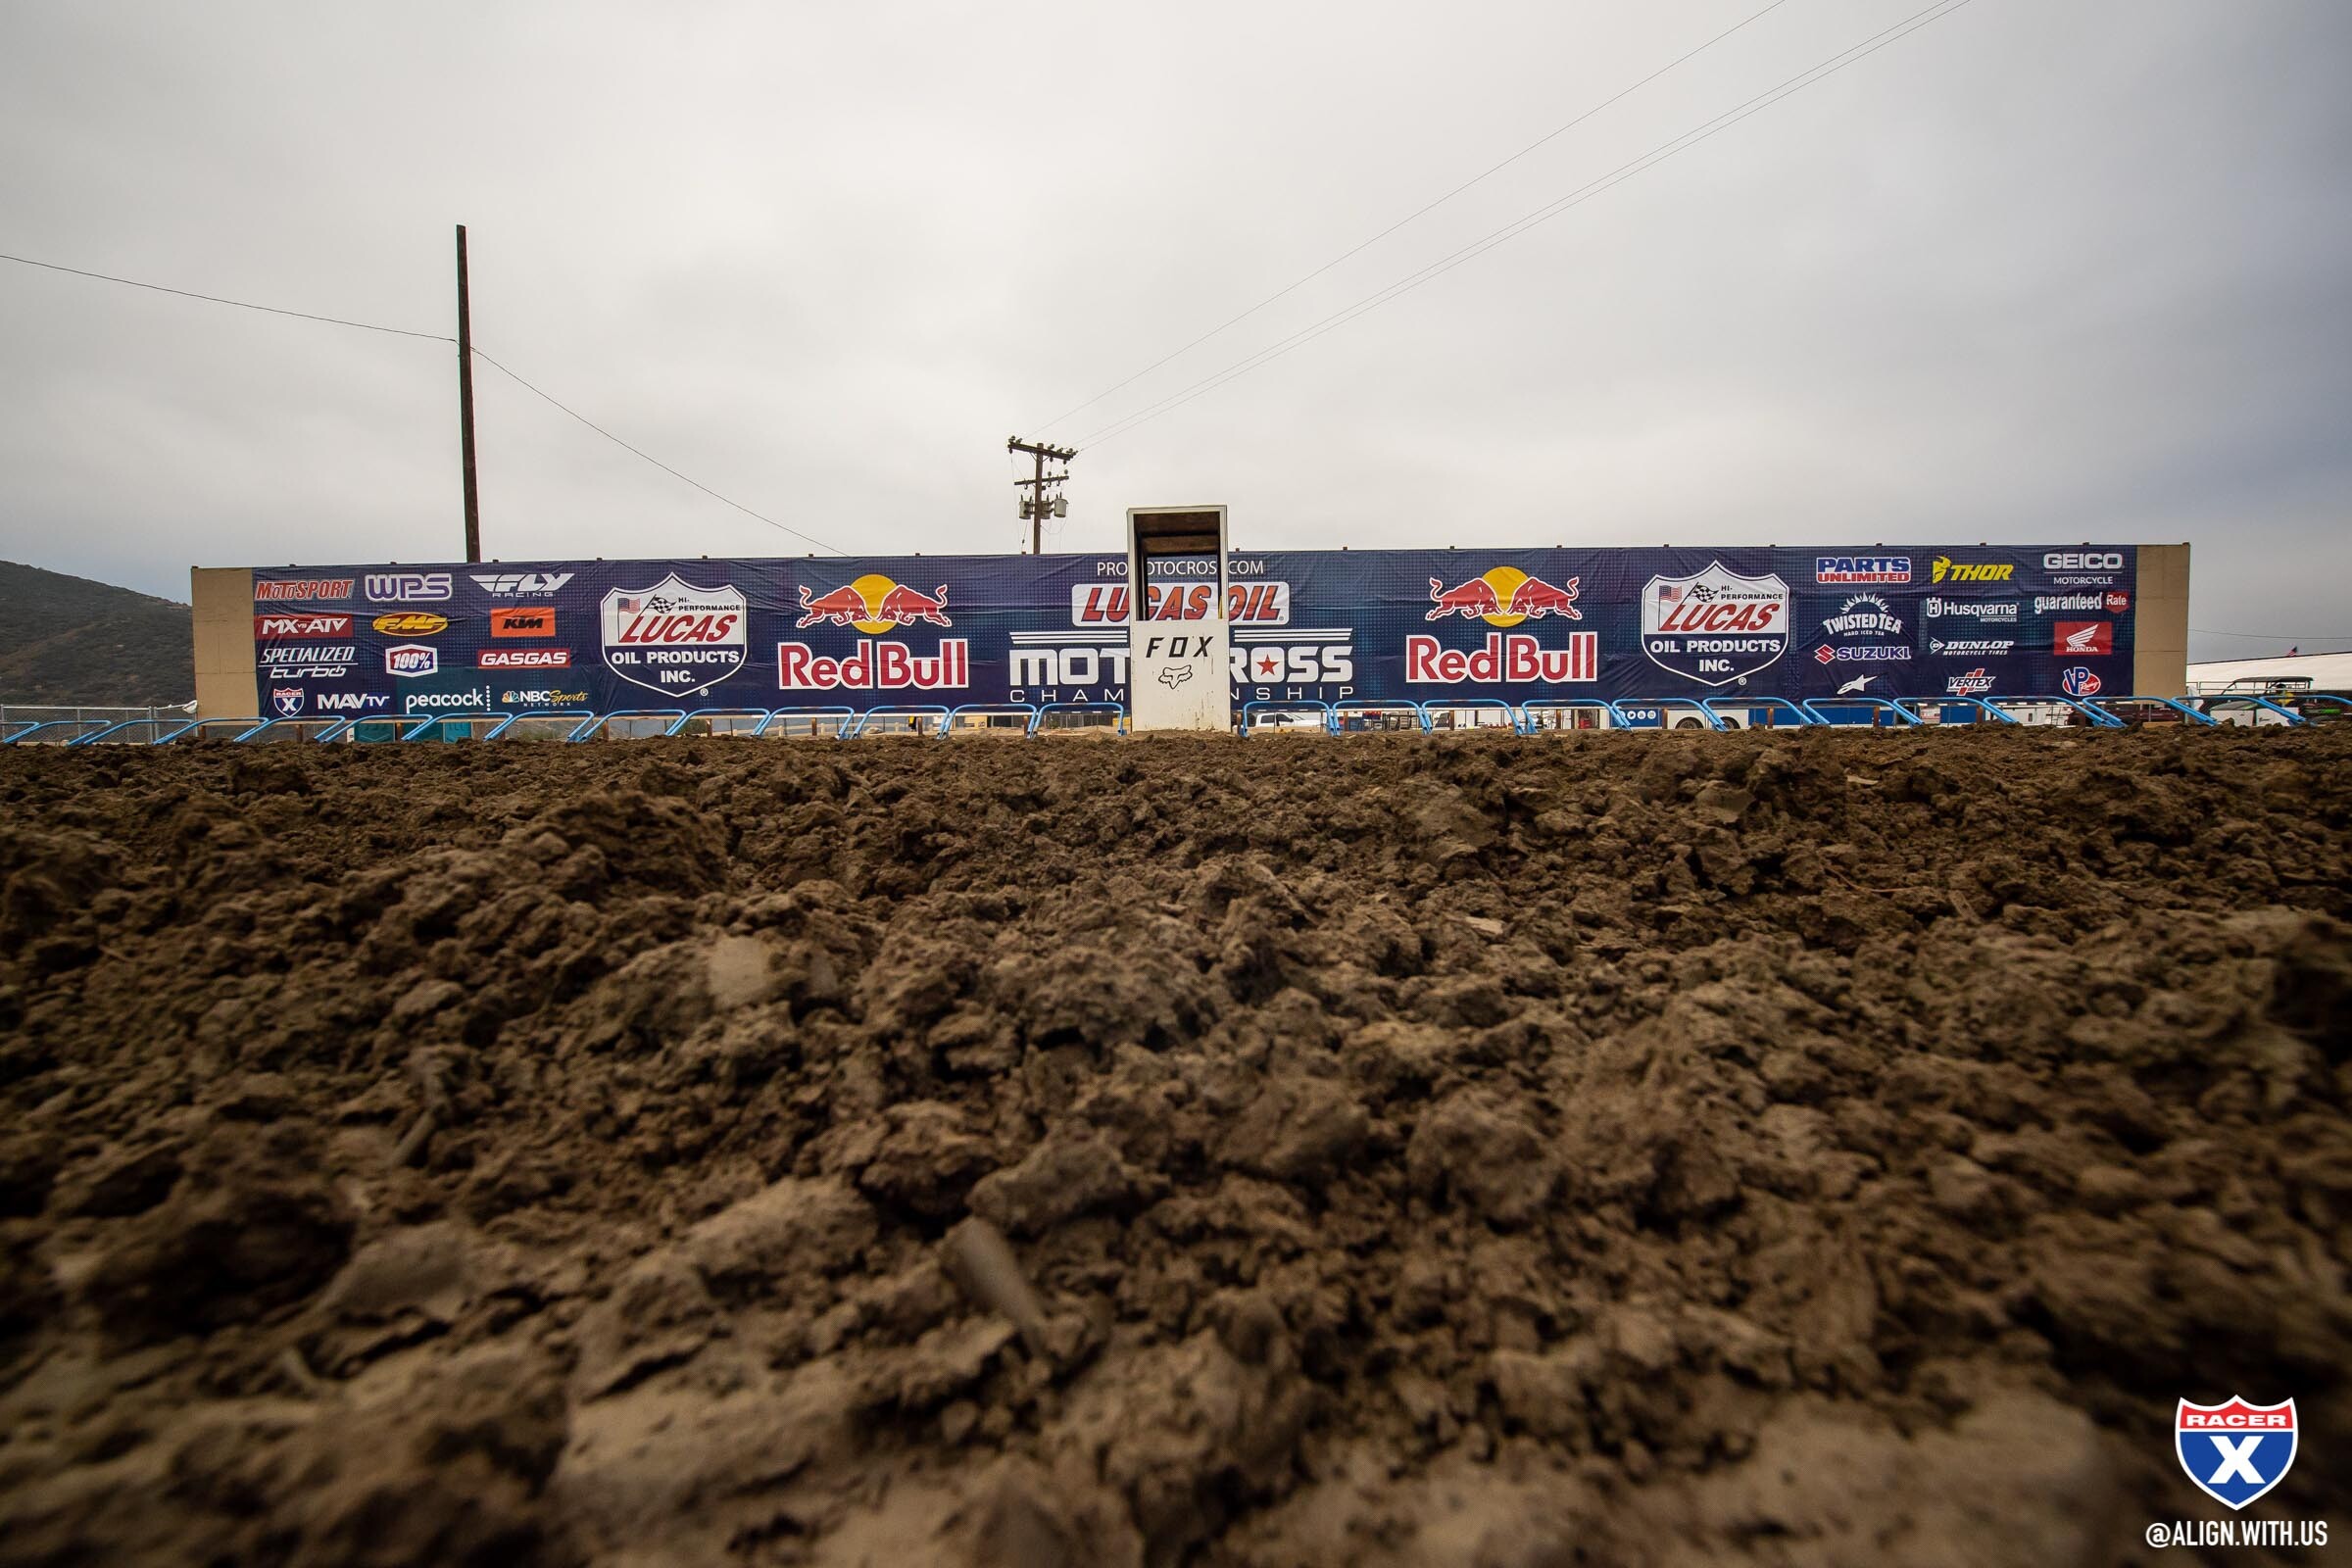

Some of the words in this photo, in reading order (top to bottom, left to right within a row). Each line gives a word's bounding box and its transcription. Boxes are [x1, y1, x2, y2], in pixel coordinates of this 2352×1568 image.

[1097, 560, 1264, 576] PROOTOCROSCOM
[1817, 557, 1910, 573] PARTS
[2043, 553, 2123, 569] GEICO
[1817, 572, 1910, 583] UNLIMITED
[1950, 564, 2014, 581] THOR
[2053, 576, 2114, 585] MOTORCYCLE
[365, 573, 452, 602] WPS
[468, 572, 575, 592] FLY
[1228, 584, 1280, 621] OIL
[1943, 602, 2017, 617] Husqvarna
[2034, 592, 2103, 614] guaranteed
[2106, 594, 2127, 606] Rate
[373, 614, 448, 630] FMF
[503, 615, 544, 630] KTM
[1658, 603, 1781, 632] LUCAS
[1823, 613, 1878, 635] TWISTED
[1879, 612, 1903, 634] TEA
[262, 617, 298, 635] MX
[305, 617, 349, 633] ATV
[618, 614, 738, 643] LUCAS
[1146, 636, 1214, 658] FOX
[1650, 640, 1681, 653] OIL
[1687, 639, 1781, 653] PRODUCTS
[1944, 641, 2015, 650] DUNLOP
[260, 647, 355, 663] SPECIALIZED
[393, 652, 430, 669] 100%
[480, 652, 567, 666] GASGAS
[612, 652, 642, 664] OIL
[647, 651, 740, 663] PRODUCTS
[1406, 632, 1502, 683] Red
[1506, 631, 1598, 682] Bull
[1837, 647, 1911, 661] SUZUKI
[778, 639, 873, 690] Red
[877, 638, 969, 689] Bull
[1009, 646, 1352, 686] MOTROSS
[1699, 659, 1735, 672] INC.
[270, 666, 347, 679] turbo
[661, 670, 695, 683] INC.
[1948, 676, 1996, 688] VERTEX
[2063, 666, 2089, 696] VP
[318, 693, 390, 710] MAVTV
[407, 688, 484, 713] peacock
[519, 690, 551, 703] NBC
[549, 689, 588, 705] Sports
[1009, 686, 1353, 703] CHAMNSHIP
[282, 697, 297, 711] X
